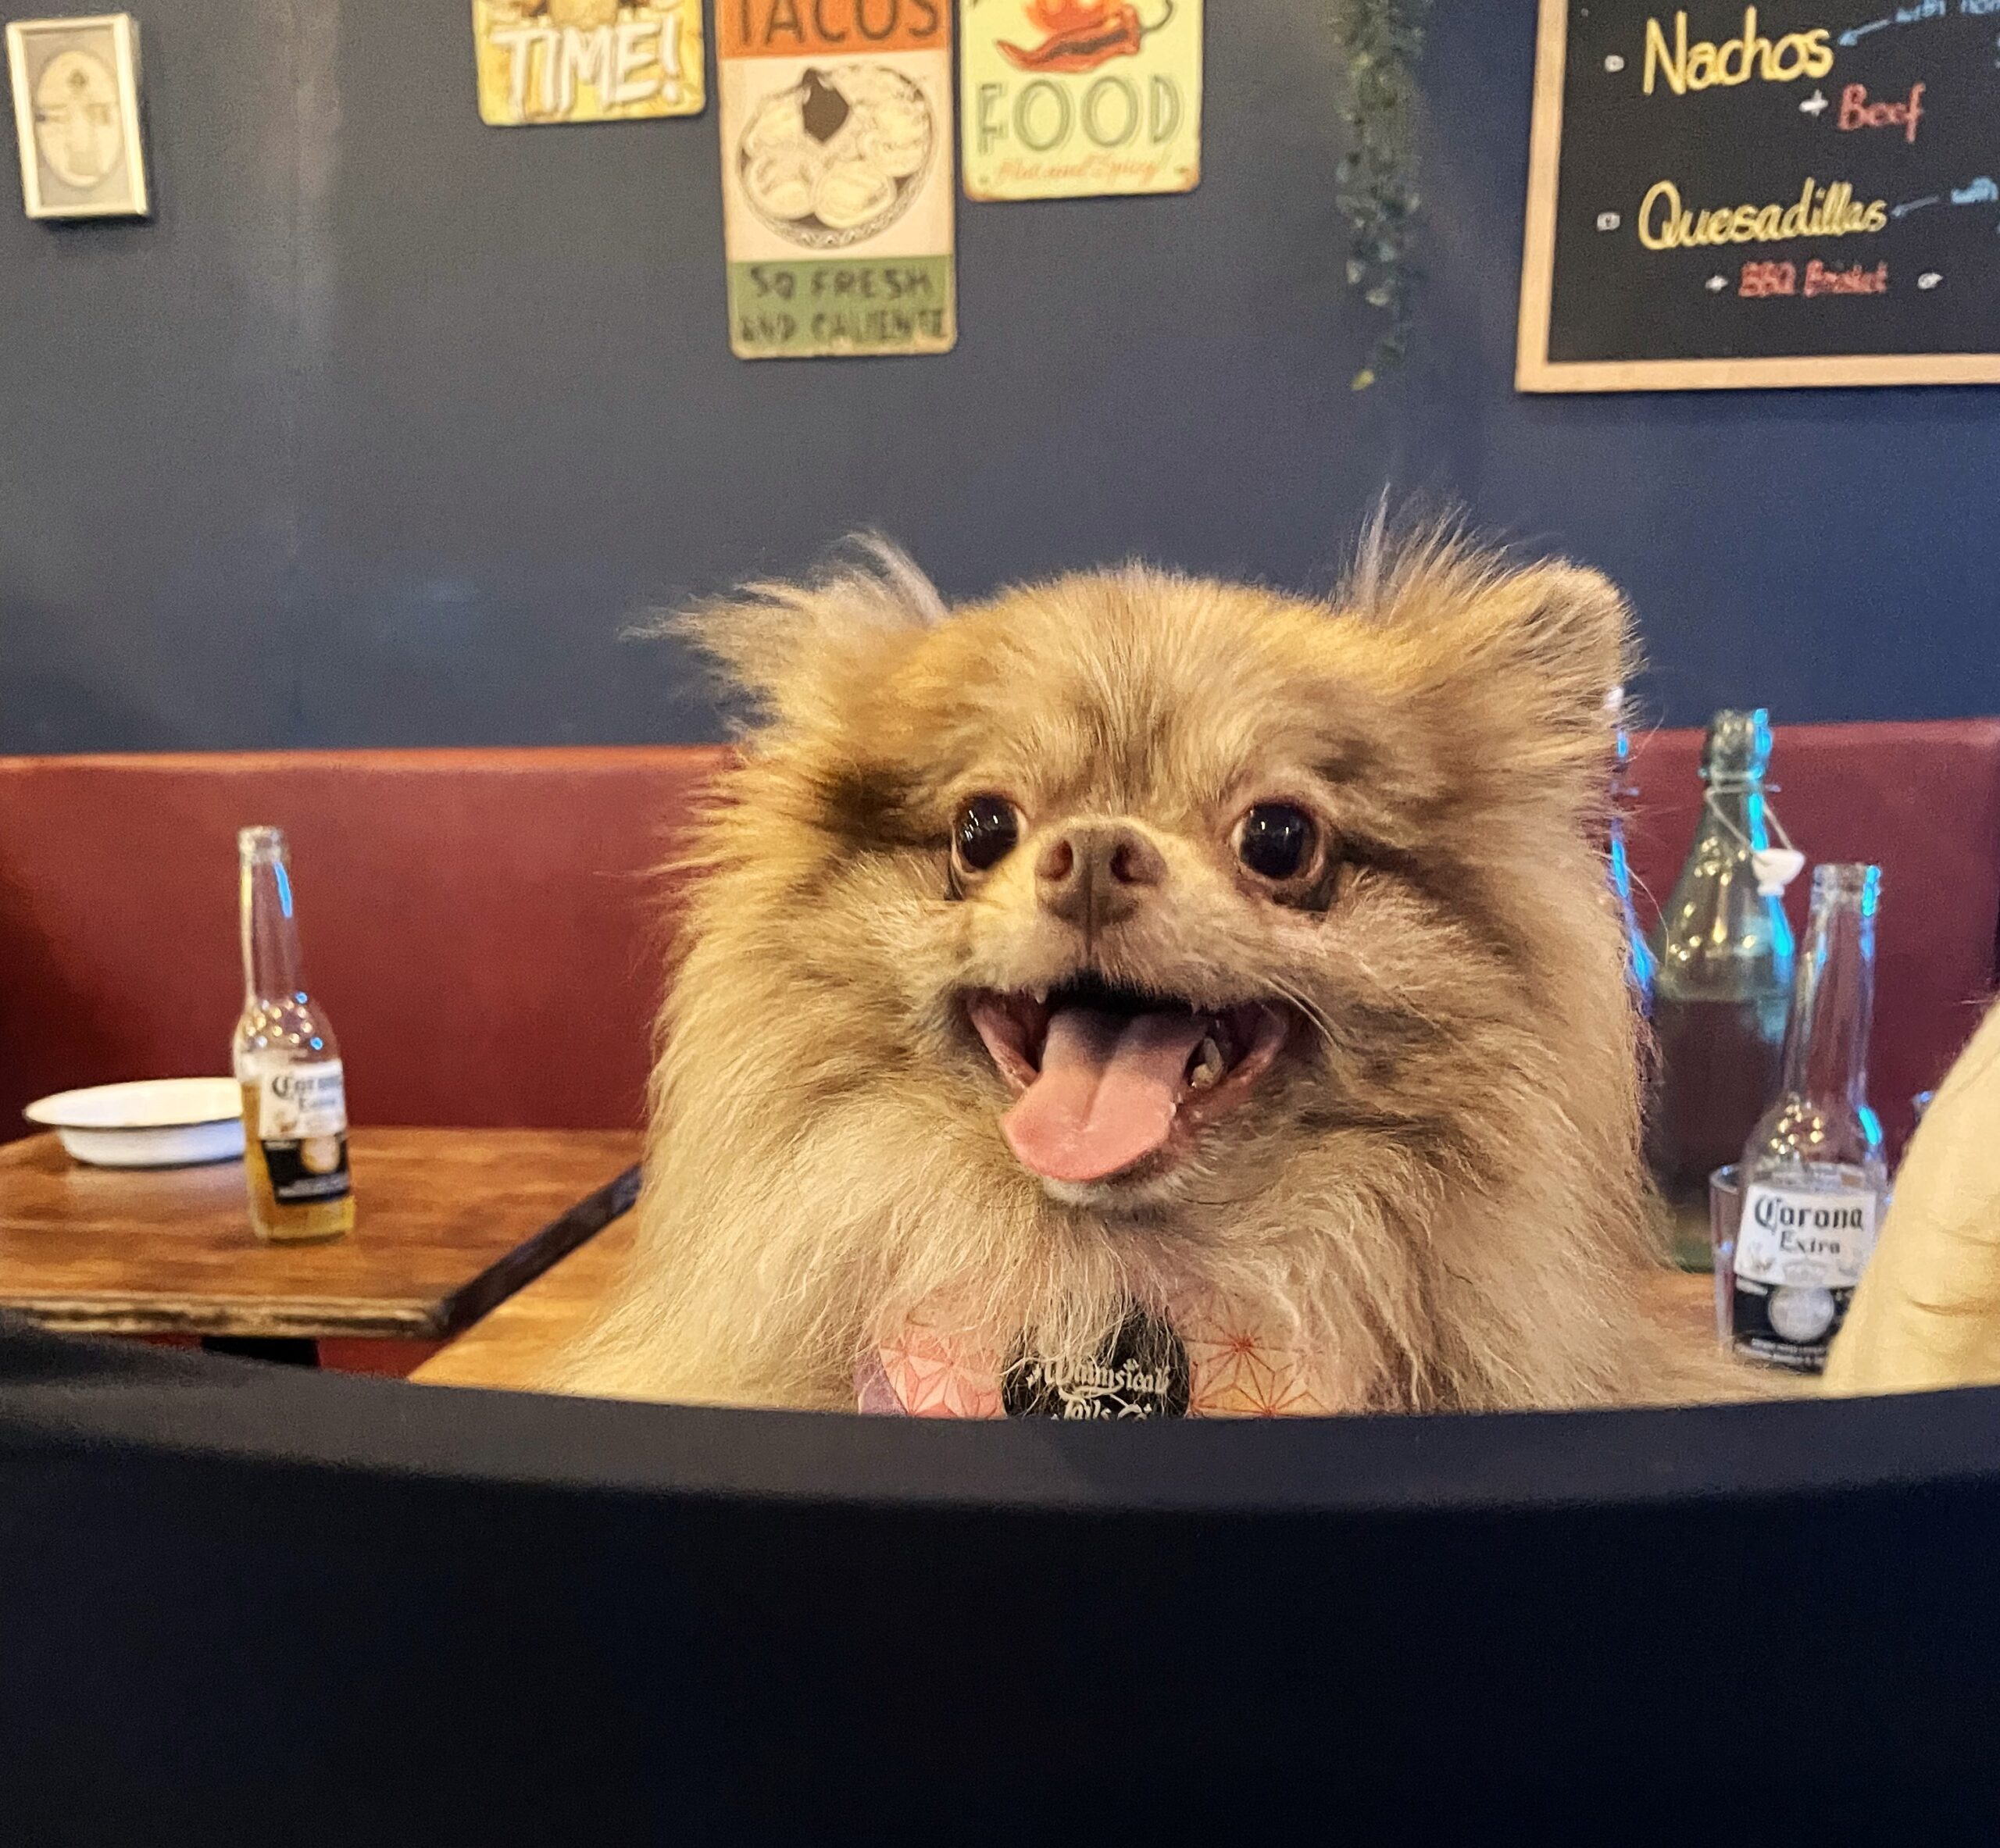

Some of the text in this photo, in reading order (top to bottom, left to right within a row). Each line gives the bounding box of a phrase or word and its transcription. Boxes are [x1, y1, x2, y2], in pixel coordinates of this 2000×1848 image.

[491, 12, 680, 123] TIME!
[1643, 5, 1834, 95] Nachos
[977, 76, 1184, 156] FOOD
[1837, 82, 1926, 144] Beef
[1639, 177, 1889, 250] Quesadillas
[810, 266, 932, 298] FRESH
[1755, 1194, 1863, 1234] Corona
[1779, 1230, 1841, 1254] Extra
